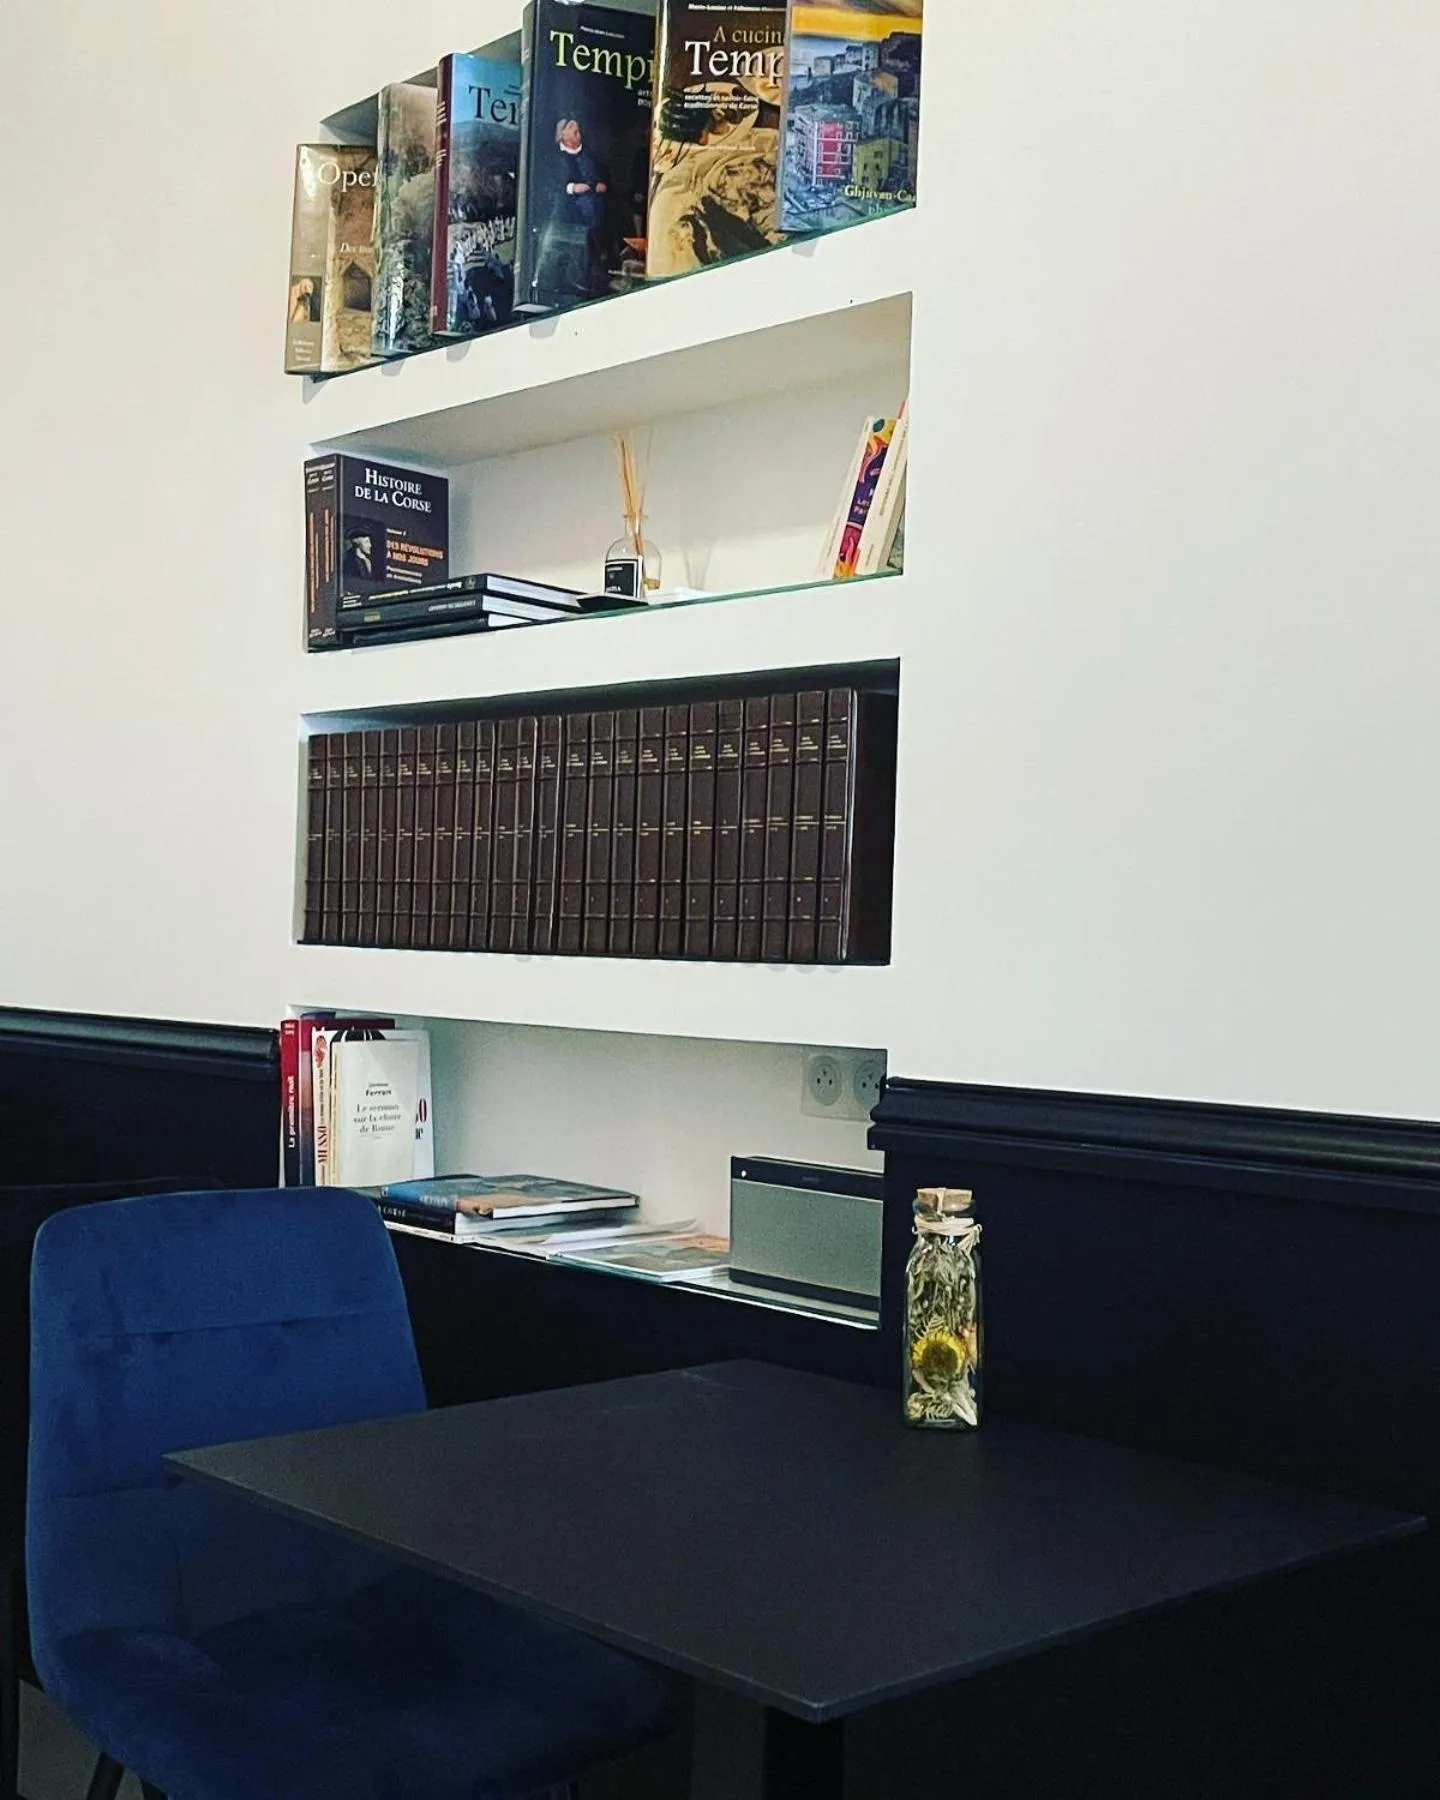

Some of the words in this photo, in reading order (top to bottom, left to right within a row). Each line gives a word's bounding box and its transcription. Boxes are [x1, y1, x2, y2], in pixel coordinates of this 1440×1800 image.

[714, 26, 726, 42] A
[365, 467, 422, 494] HISTOIRE
[354, 485, 372, 500] DE
[374, 489, 389, 504] LA
[391, 490, 433, 513] CORSE
